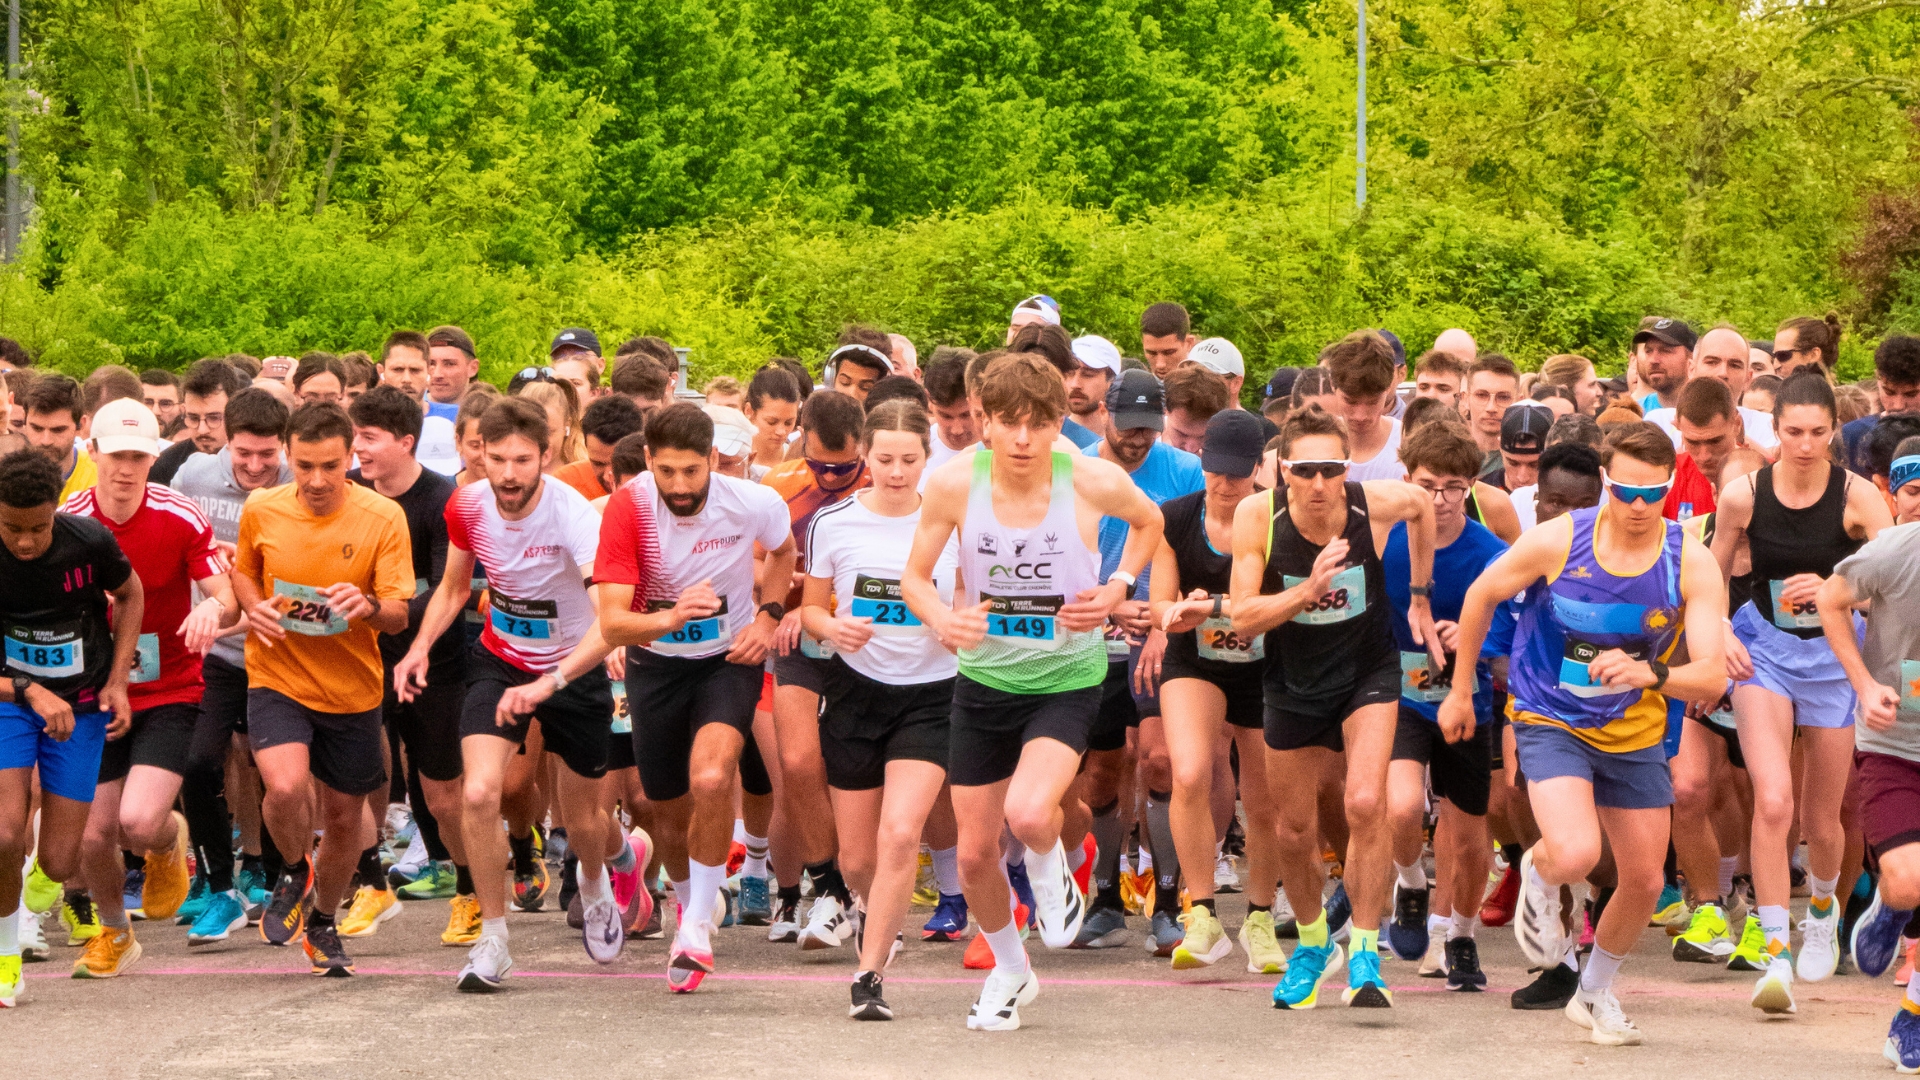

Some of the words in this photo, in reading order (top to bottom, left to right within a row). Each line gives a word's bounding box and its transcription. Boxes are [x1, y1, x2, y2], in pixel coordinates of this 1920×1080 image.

[1197, 343, 1220, 355] wilo
[287, 600, 331, 623] 224
[875, 604, 906, 624] 23
[504, 616, 533, 637] 73
[671, 624, 703, 642] 66
[997, 618, 1046, 638] 149
[19, 646, 66, 666] 183
[1577, 648, 1594, 657] TDR
